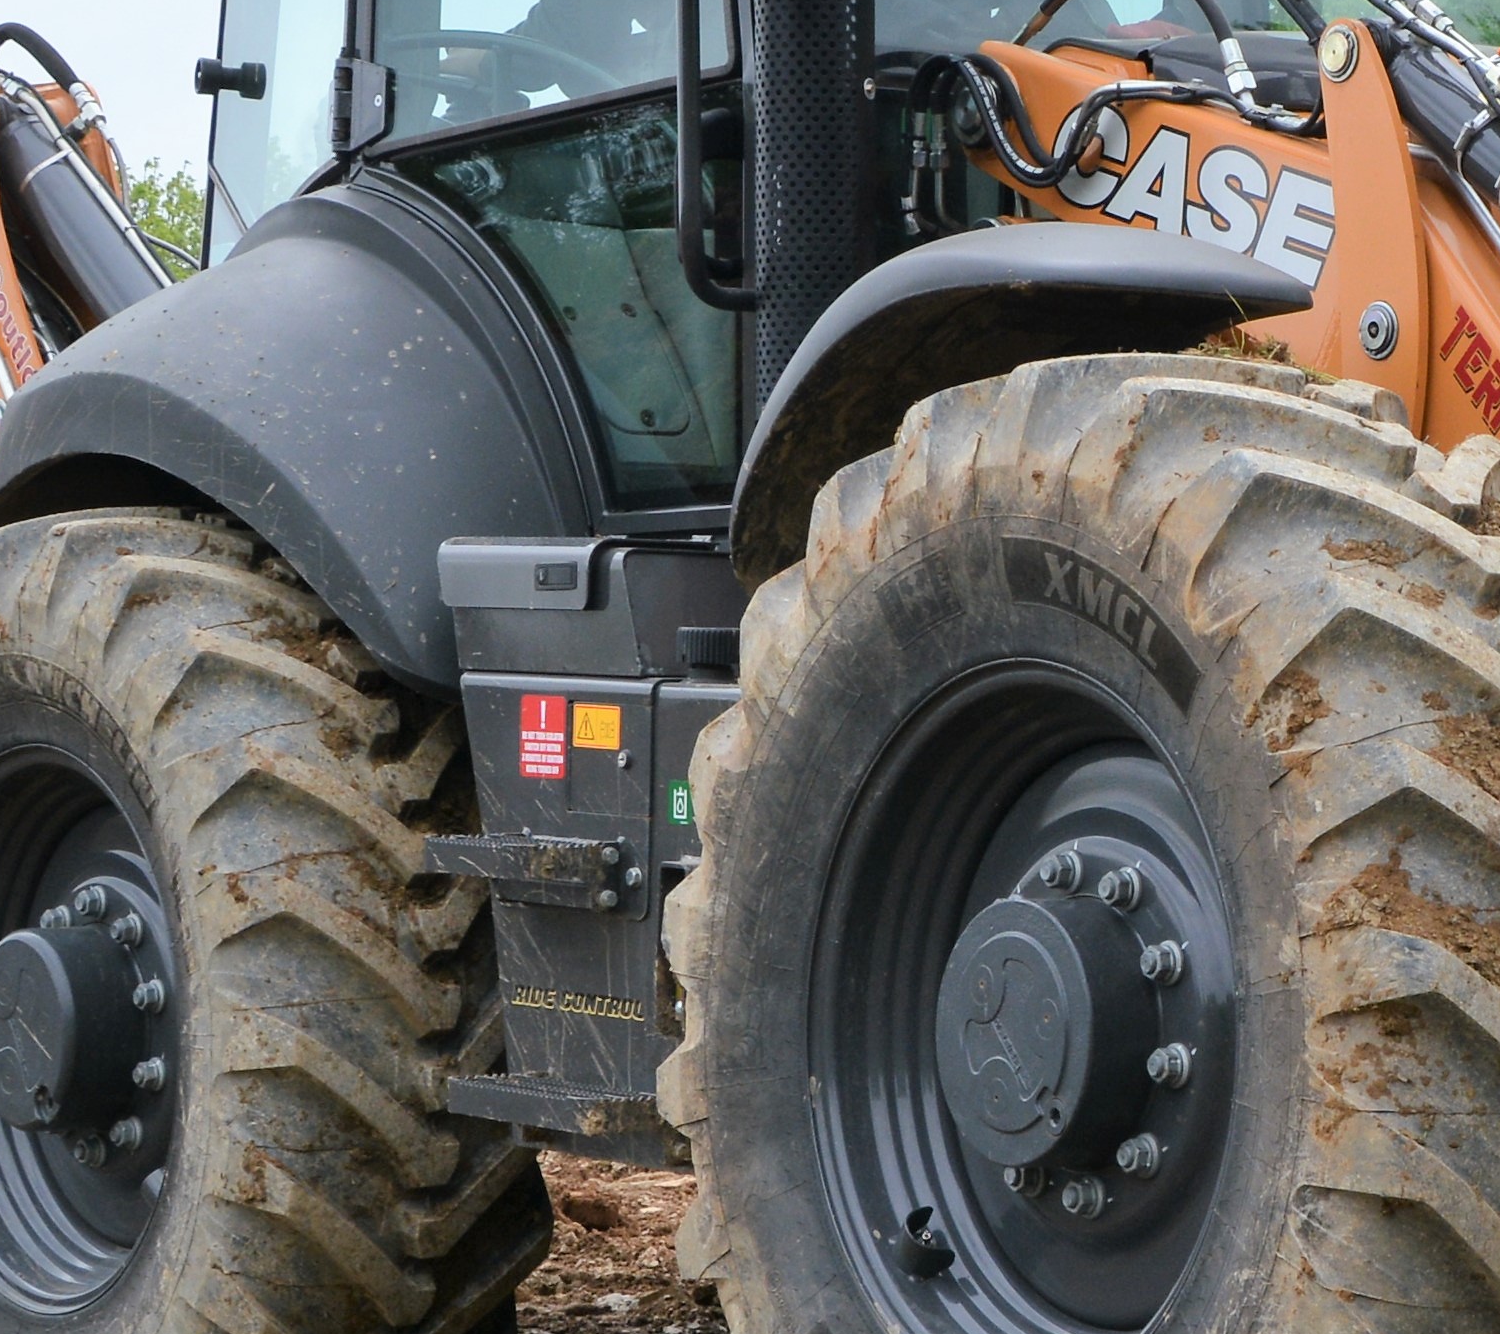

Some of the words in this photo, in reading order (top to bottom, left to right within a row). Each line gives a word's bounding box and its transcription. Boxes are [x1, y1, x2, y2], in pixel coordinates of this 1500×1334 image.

[1052, 101, 1337, 292] CASE
[1043, 552, 1158, 671] XMCL
[511, 985, 557, 1009] RIDE
[559, 991, 645, 1022] CONTROL
